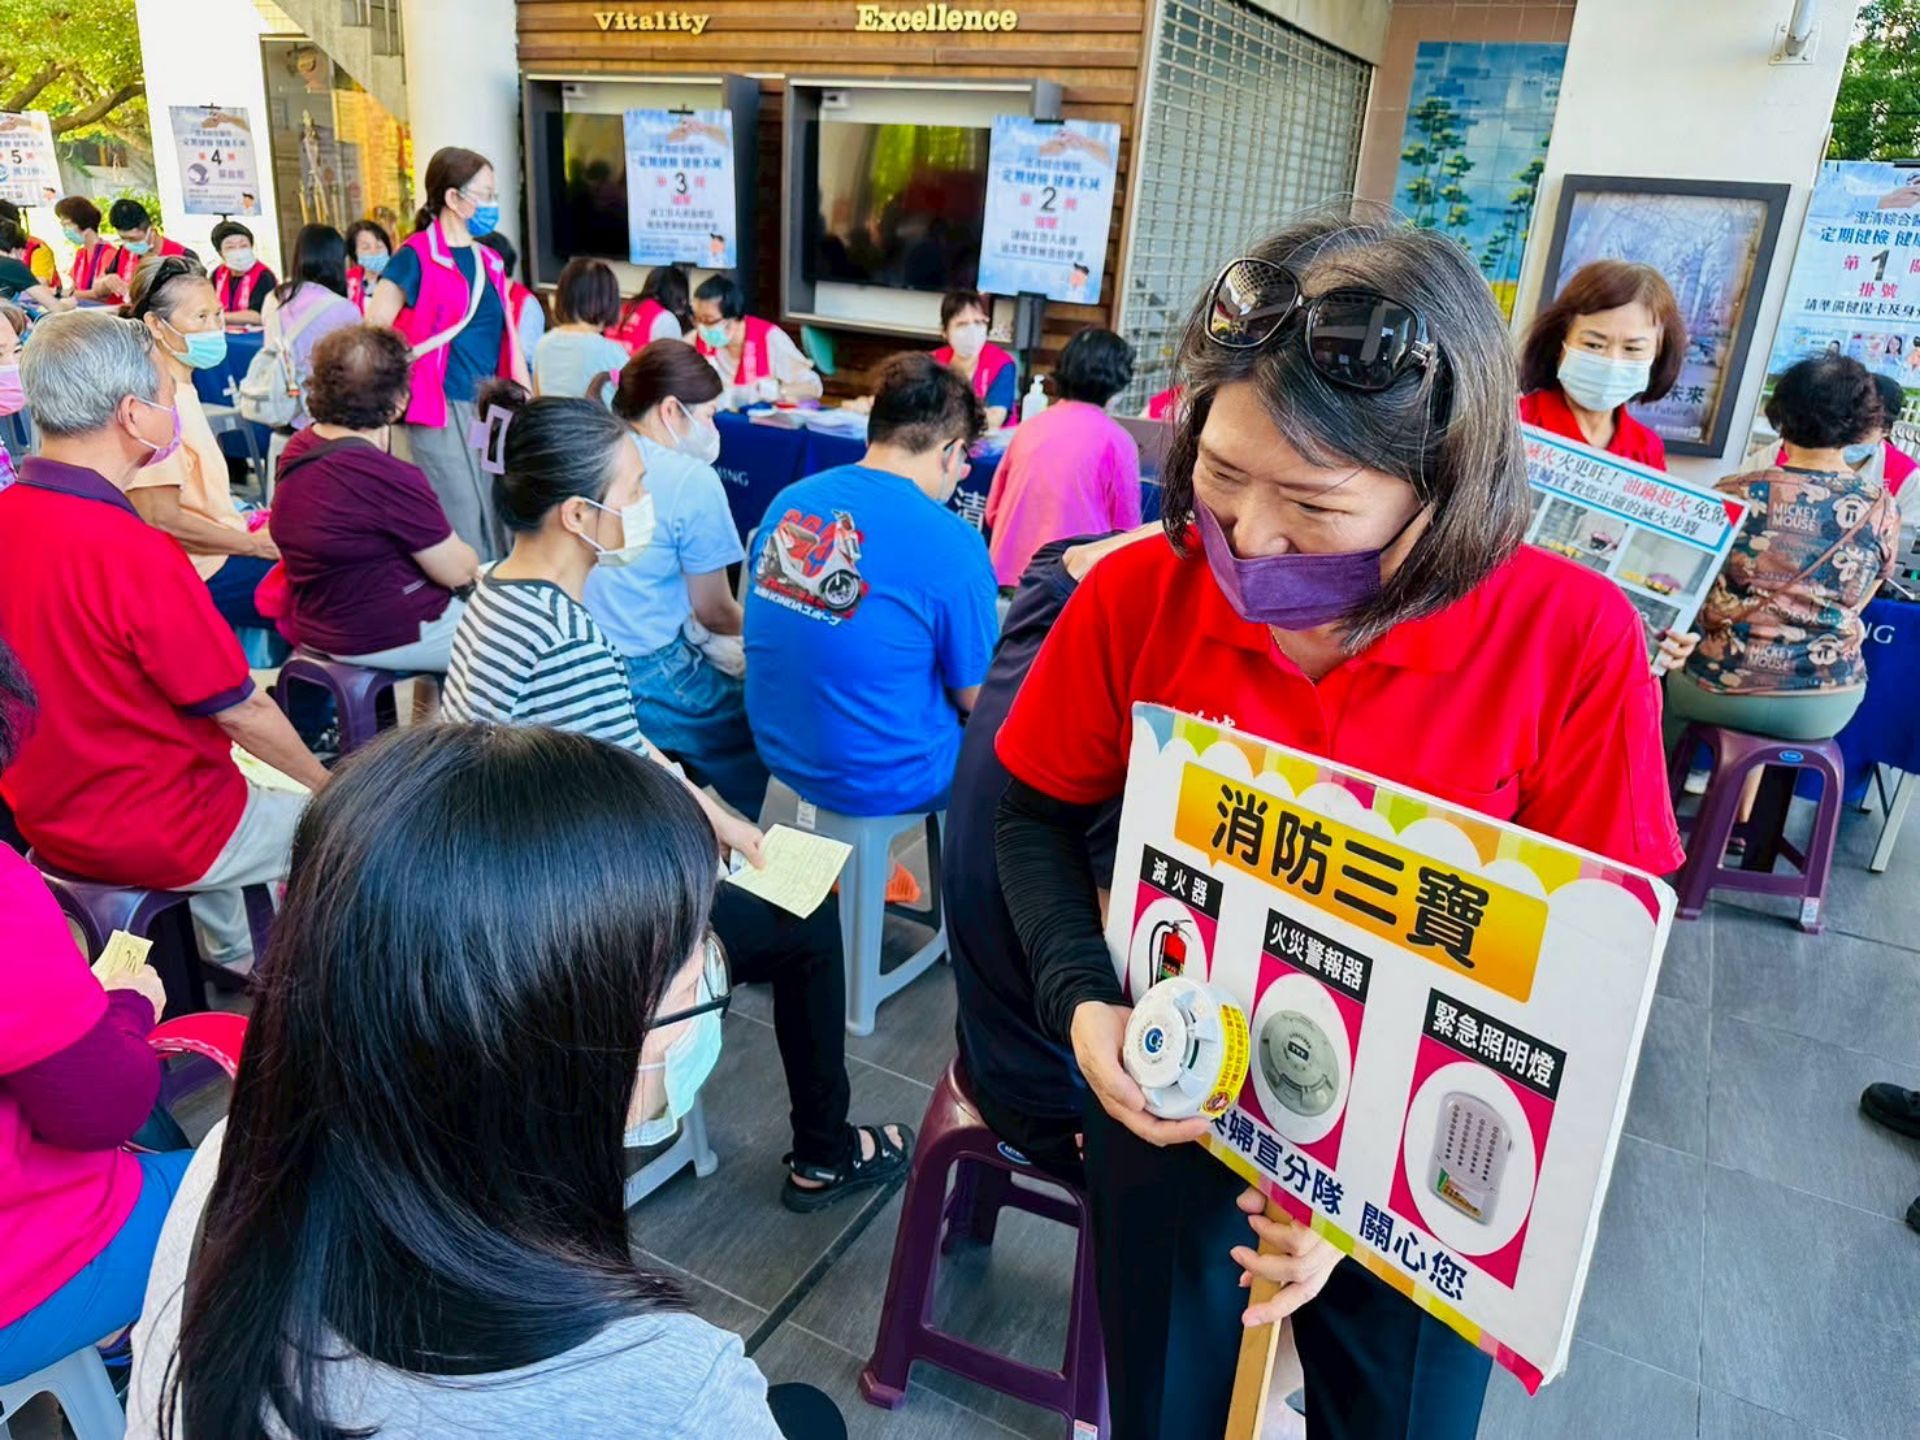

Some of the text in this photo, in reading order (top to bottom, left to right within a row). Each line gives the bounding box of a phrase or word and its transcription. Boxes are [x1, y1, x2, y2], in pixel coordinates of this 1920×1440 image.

[593, 11, 711, 35] Vitality
[855, 3, 1018, 33] Excellence
[11, 149, 22, 164] 5
[211, 149, 222, 166] 4
[675, 171, 688, 195] 3
[1041, 186, 1056, 213] 2
[1820, 226, 1890, 246] 定期健檢
[1871, 249, 1890, 282] 1
[1859, 281, 1898, 299] 掛號
[1803, 297, 1920, 318] 請準備健保卡及身
[1772, 503, 1820, 519] MICKEY
[1771, 515, 1817, 532] MOUSE
[1151, 856, 1208, 908] 滅火器
[1212, 784, 1490, 969] 消防三寶
[1269, 920, 1364, 991] 火災警報器
[1432, 999, 1556, 1089] 緊急照明燈
[1358, 1200, 1468, 1301] 關心您
